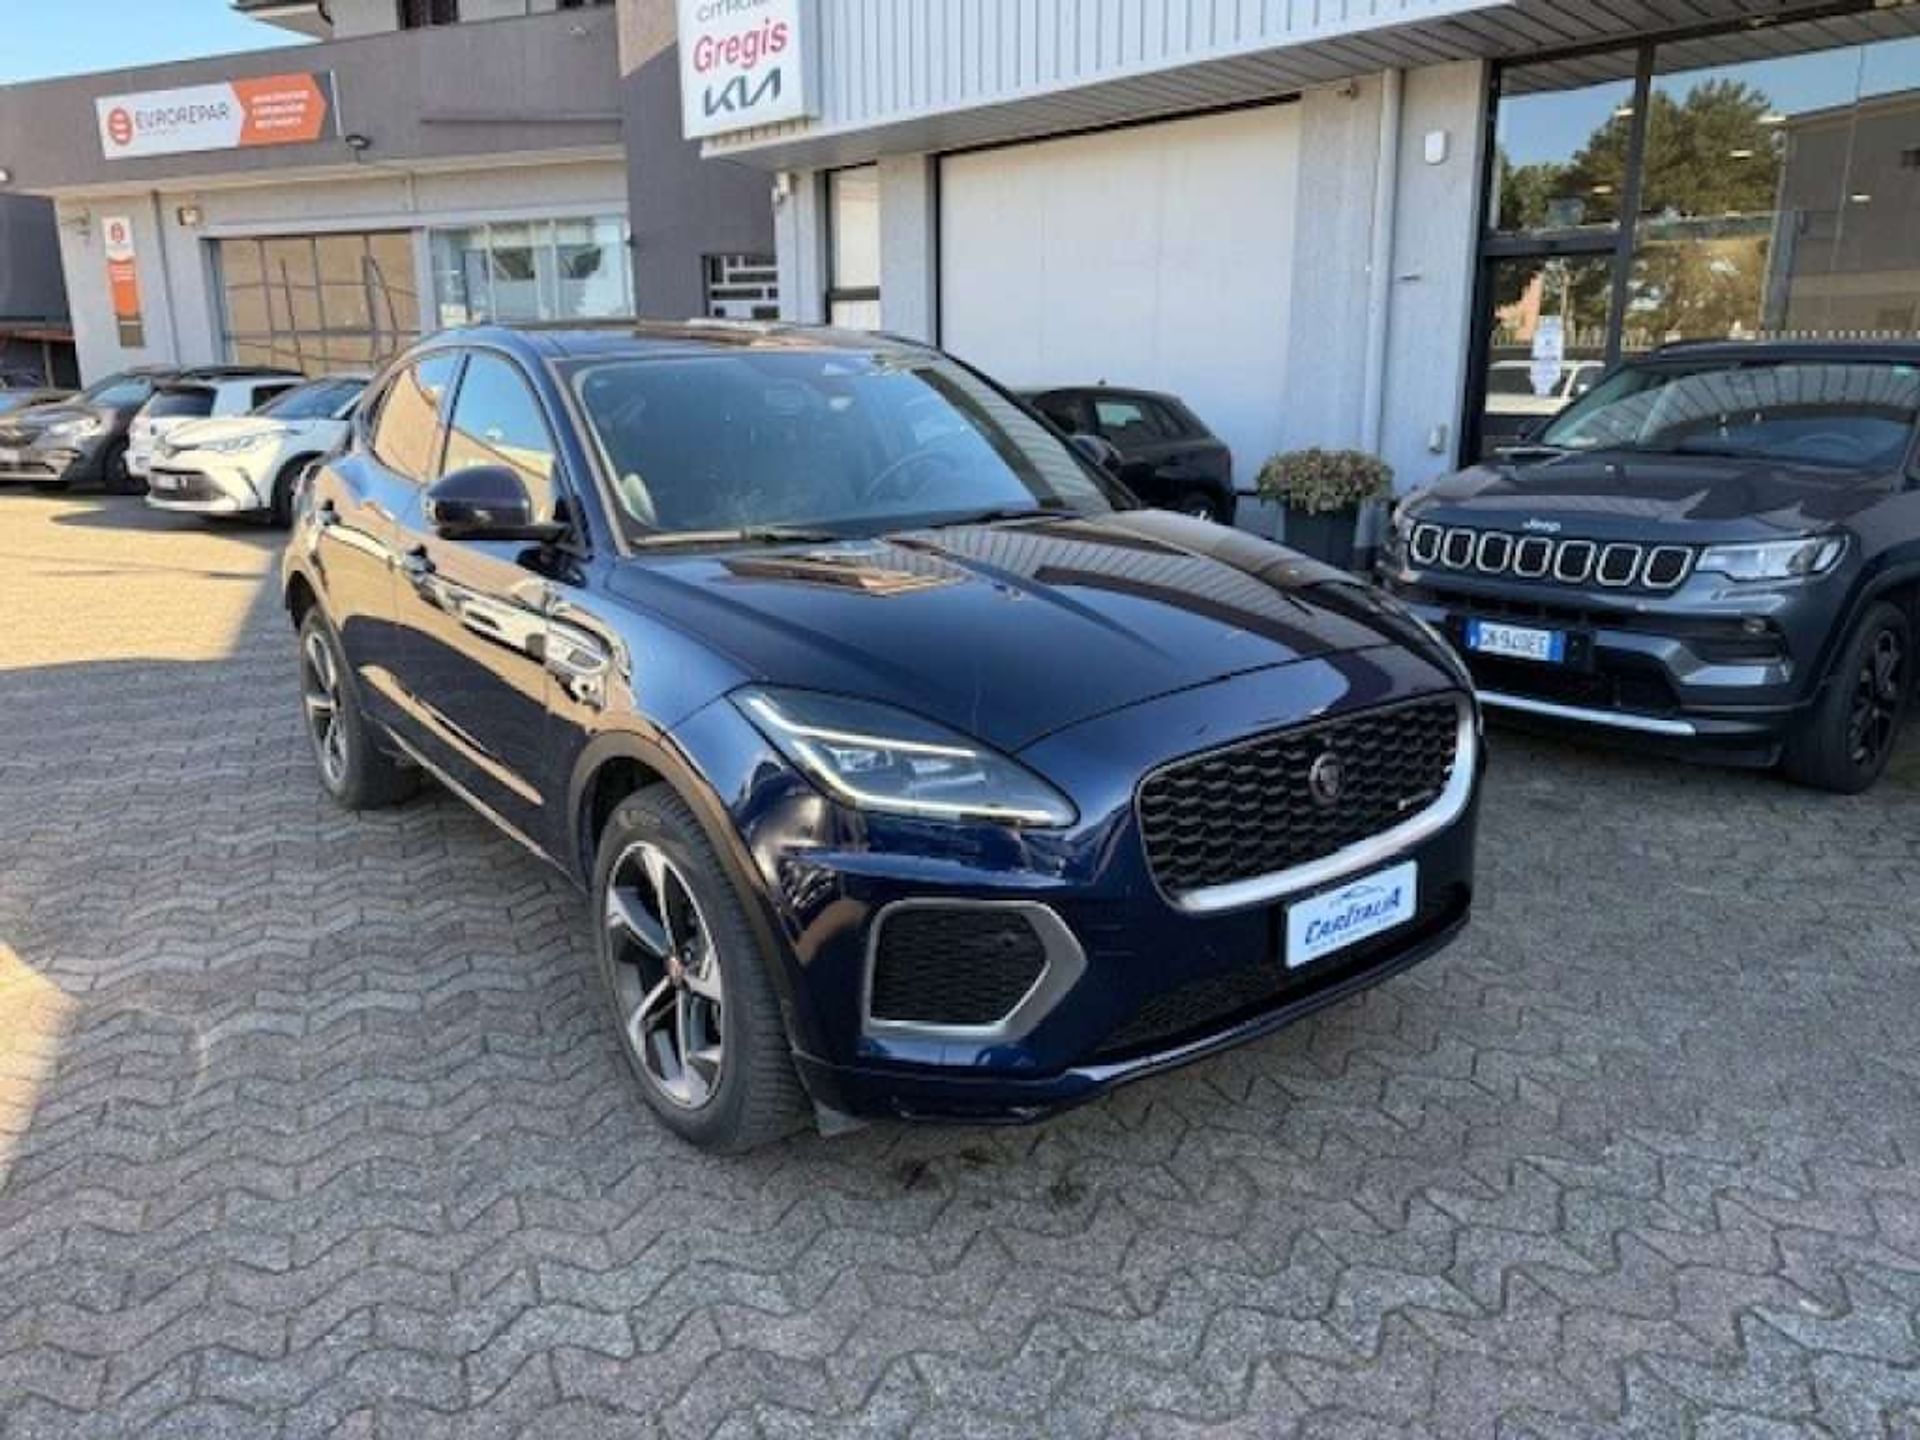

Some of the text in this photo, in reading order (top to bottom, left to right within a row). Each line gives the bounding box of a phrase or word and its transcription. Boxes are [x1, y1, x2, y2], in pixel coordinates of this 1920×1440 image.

[697, 0, 769, 22] CITRO
[694, 16, 787, 72] Gregis
[704, 66, 781, 117] KIA
[135, 102, 230, 129] EUROREPAR
